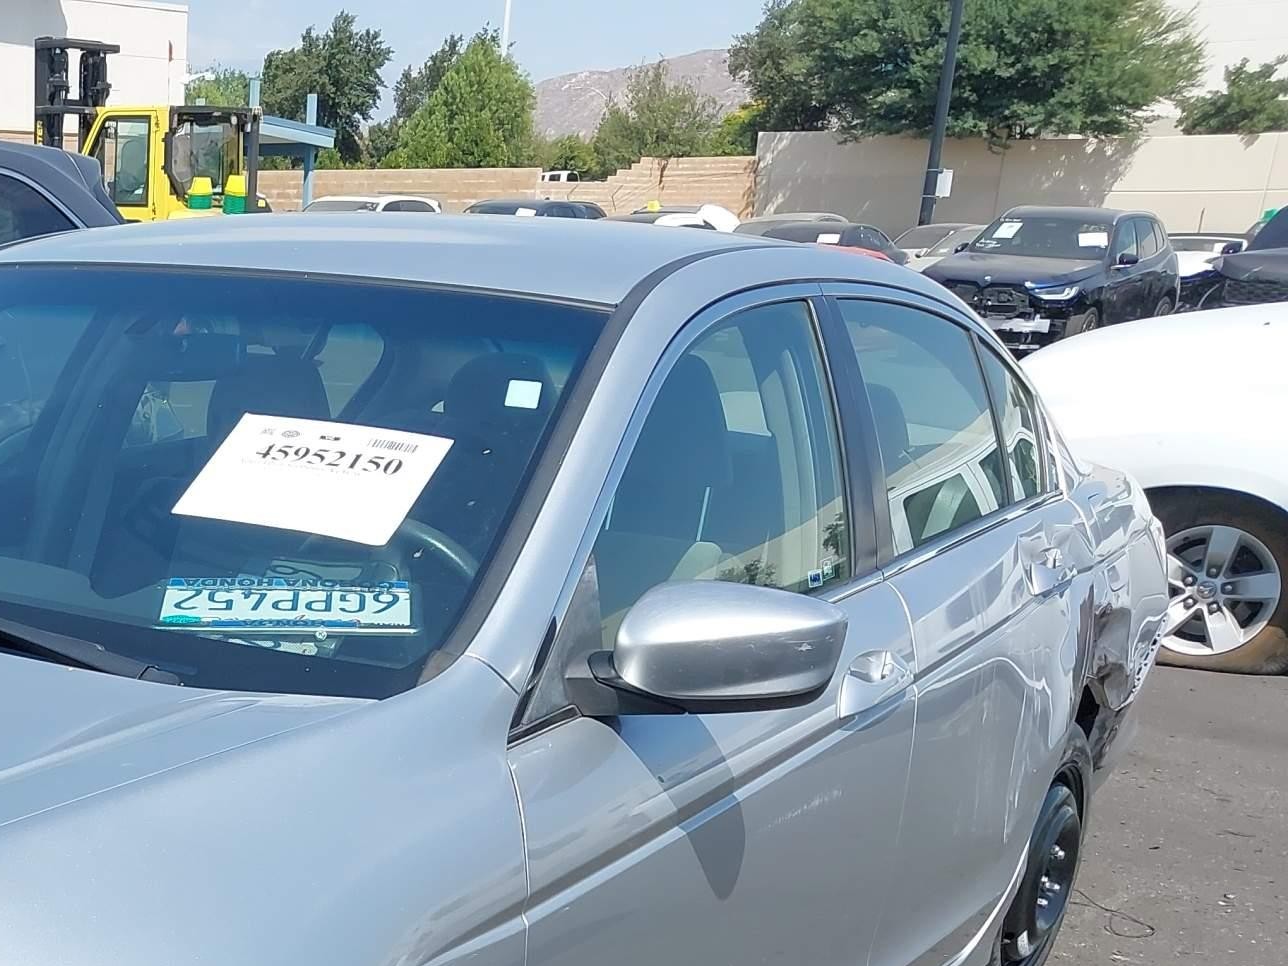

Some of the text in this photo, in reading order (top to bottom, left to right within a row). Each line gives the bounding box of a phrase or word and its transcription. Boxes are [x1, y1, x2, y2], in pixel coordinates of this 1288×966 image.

[255, 443, 404, 476] 45952150
[184, 577, 274, 588] HONDA
[173, 588, 400, 614] 6GPP452
